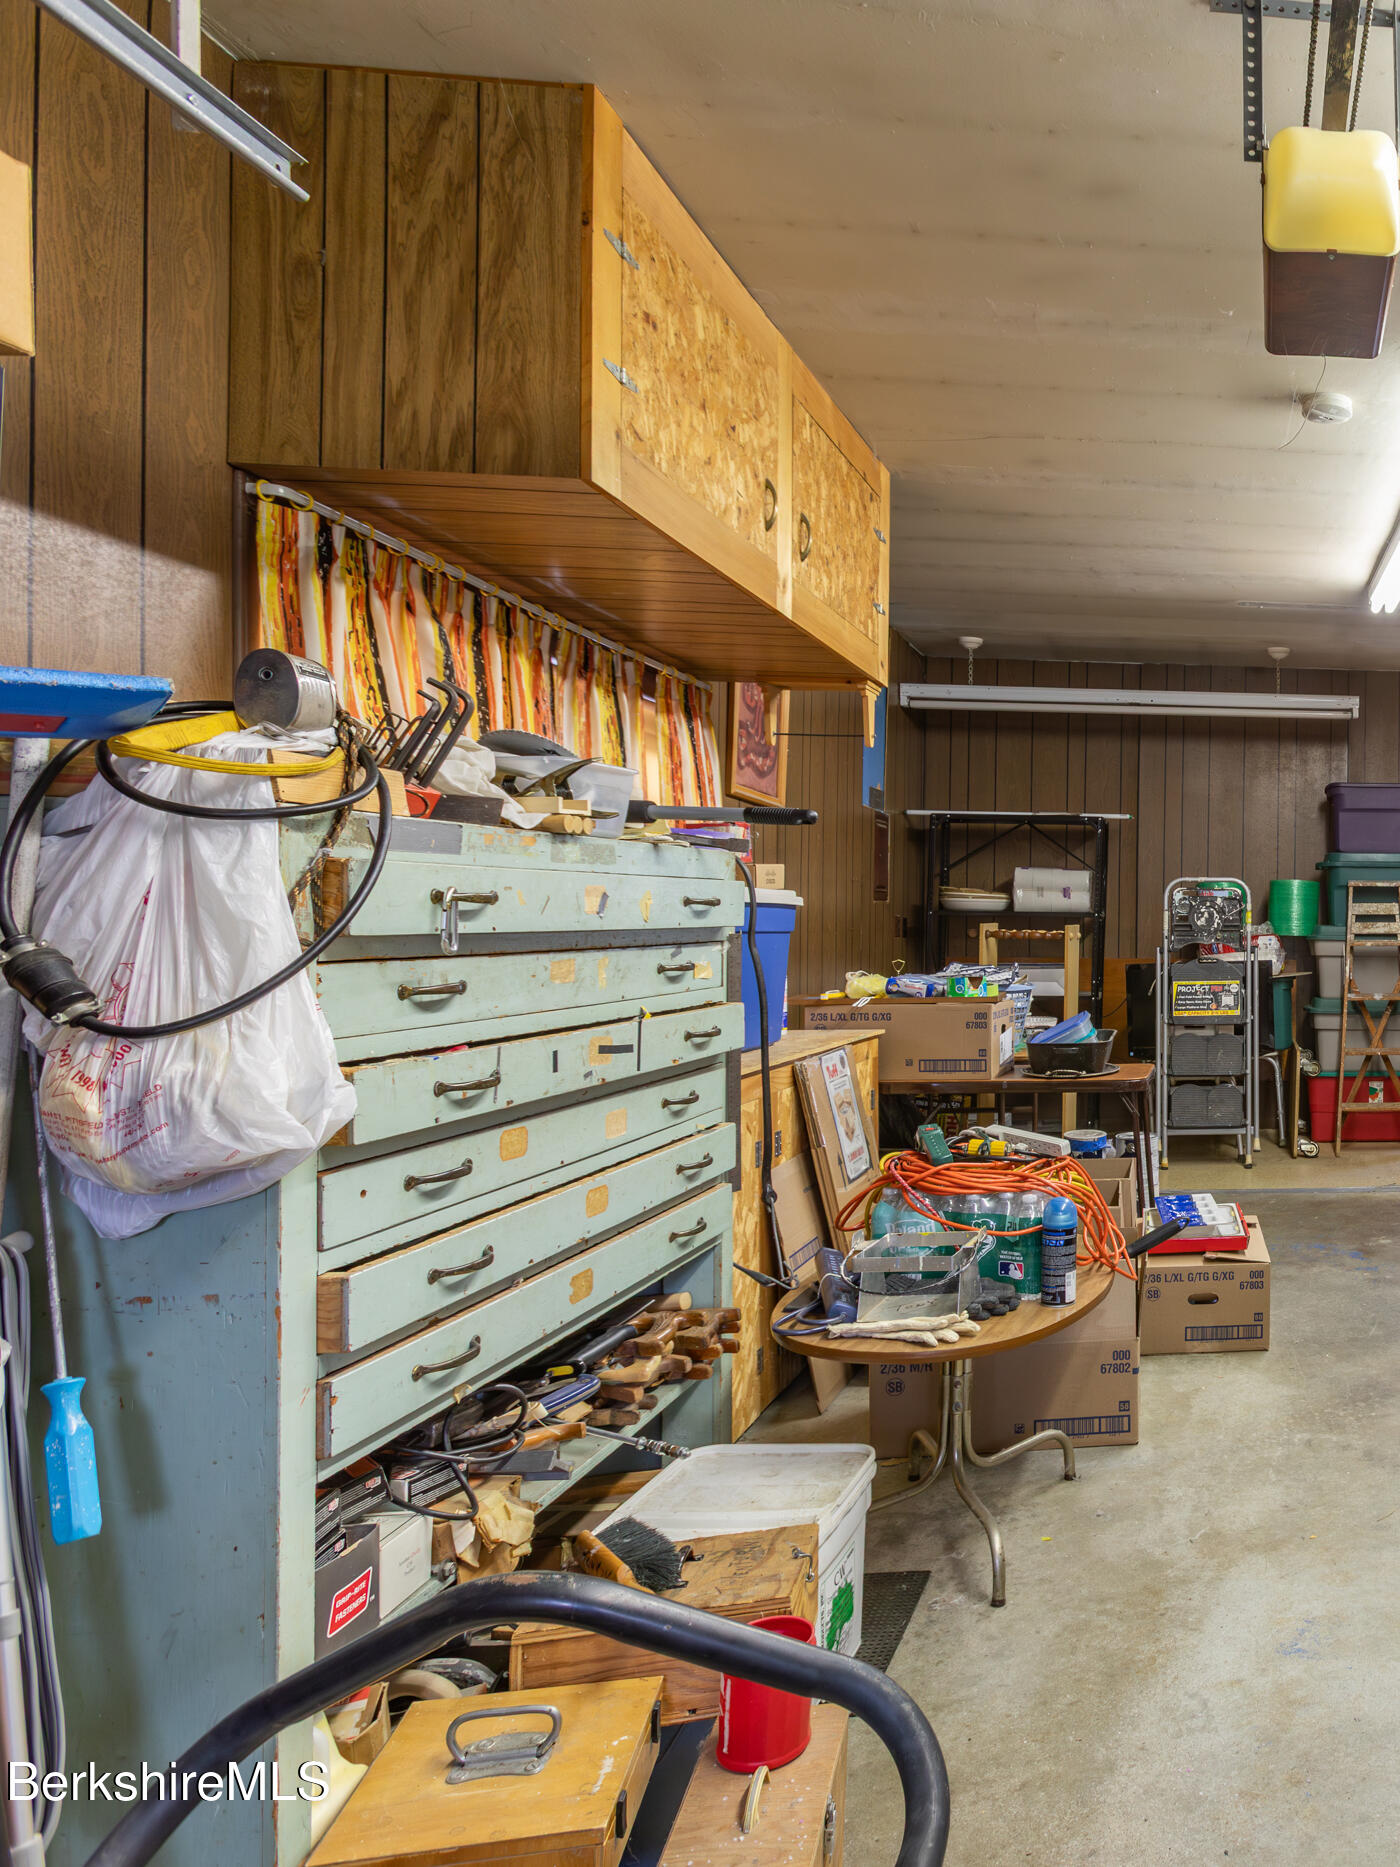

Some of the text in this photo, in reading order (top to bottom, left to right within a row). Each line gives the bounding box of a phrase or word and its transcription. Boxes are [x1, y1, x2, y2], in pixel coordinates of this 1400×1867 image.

[1177, 983, 1210, 993] PROJECT
[830, 1013, 848, 1022] L/XL
[850, 1012, 869, 1022] G/TG
[872, 1012, 892, 1021] G/XG
[974, 1012, 987, 1020] 000
[965, 1021, 988, 1030] 67803
[1164, 1273, 1184, 1283] L/XL
[1187, 1272, 1209, 1282] G/TG
[1212, 1271, 1235, 1281] G/XG
[1249, 1270, 1264, 1280] 000
[1239, 1280, 1264, 1290] 67803
[1147, 1289, 1160, 1299] SB
[1112, 1350, 1131, 1361] 000
[1100, 1363, 1131, 1374] 67802
[887, 1381, 904, 1393] SB
[335, 1580, 367, 1608] GRIP-RITE
[335, 1592, 367, 1623] FASTENERS
